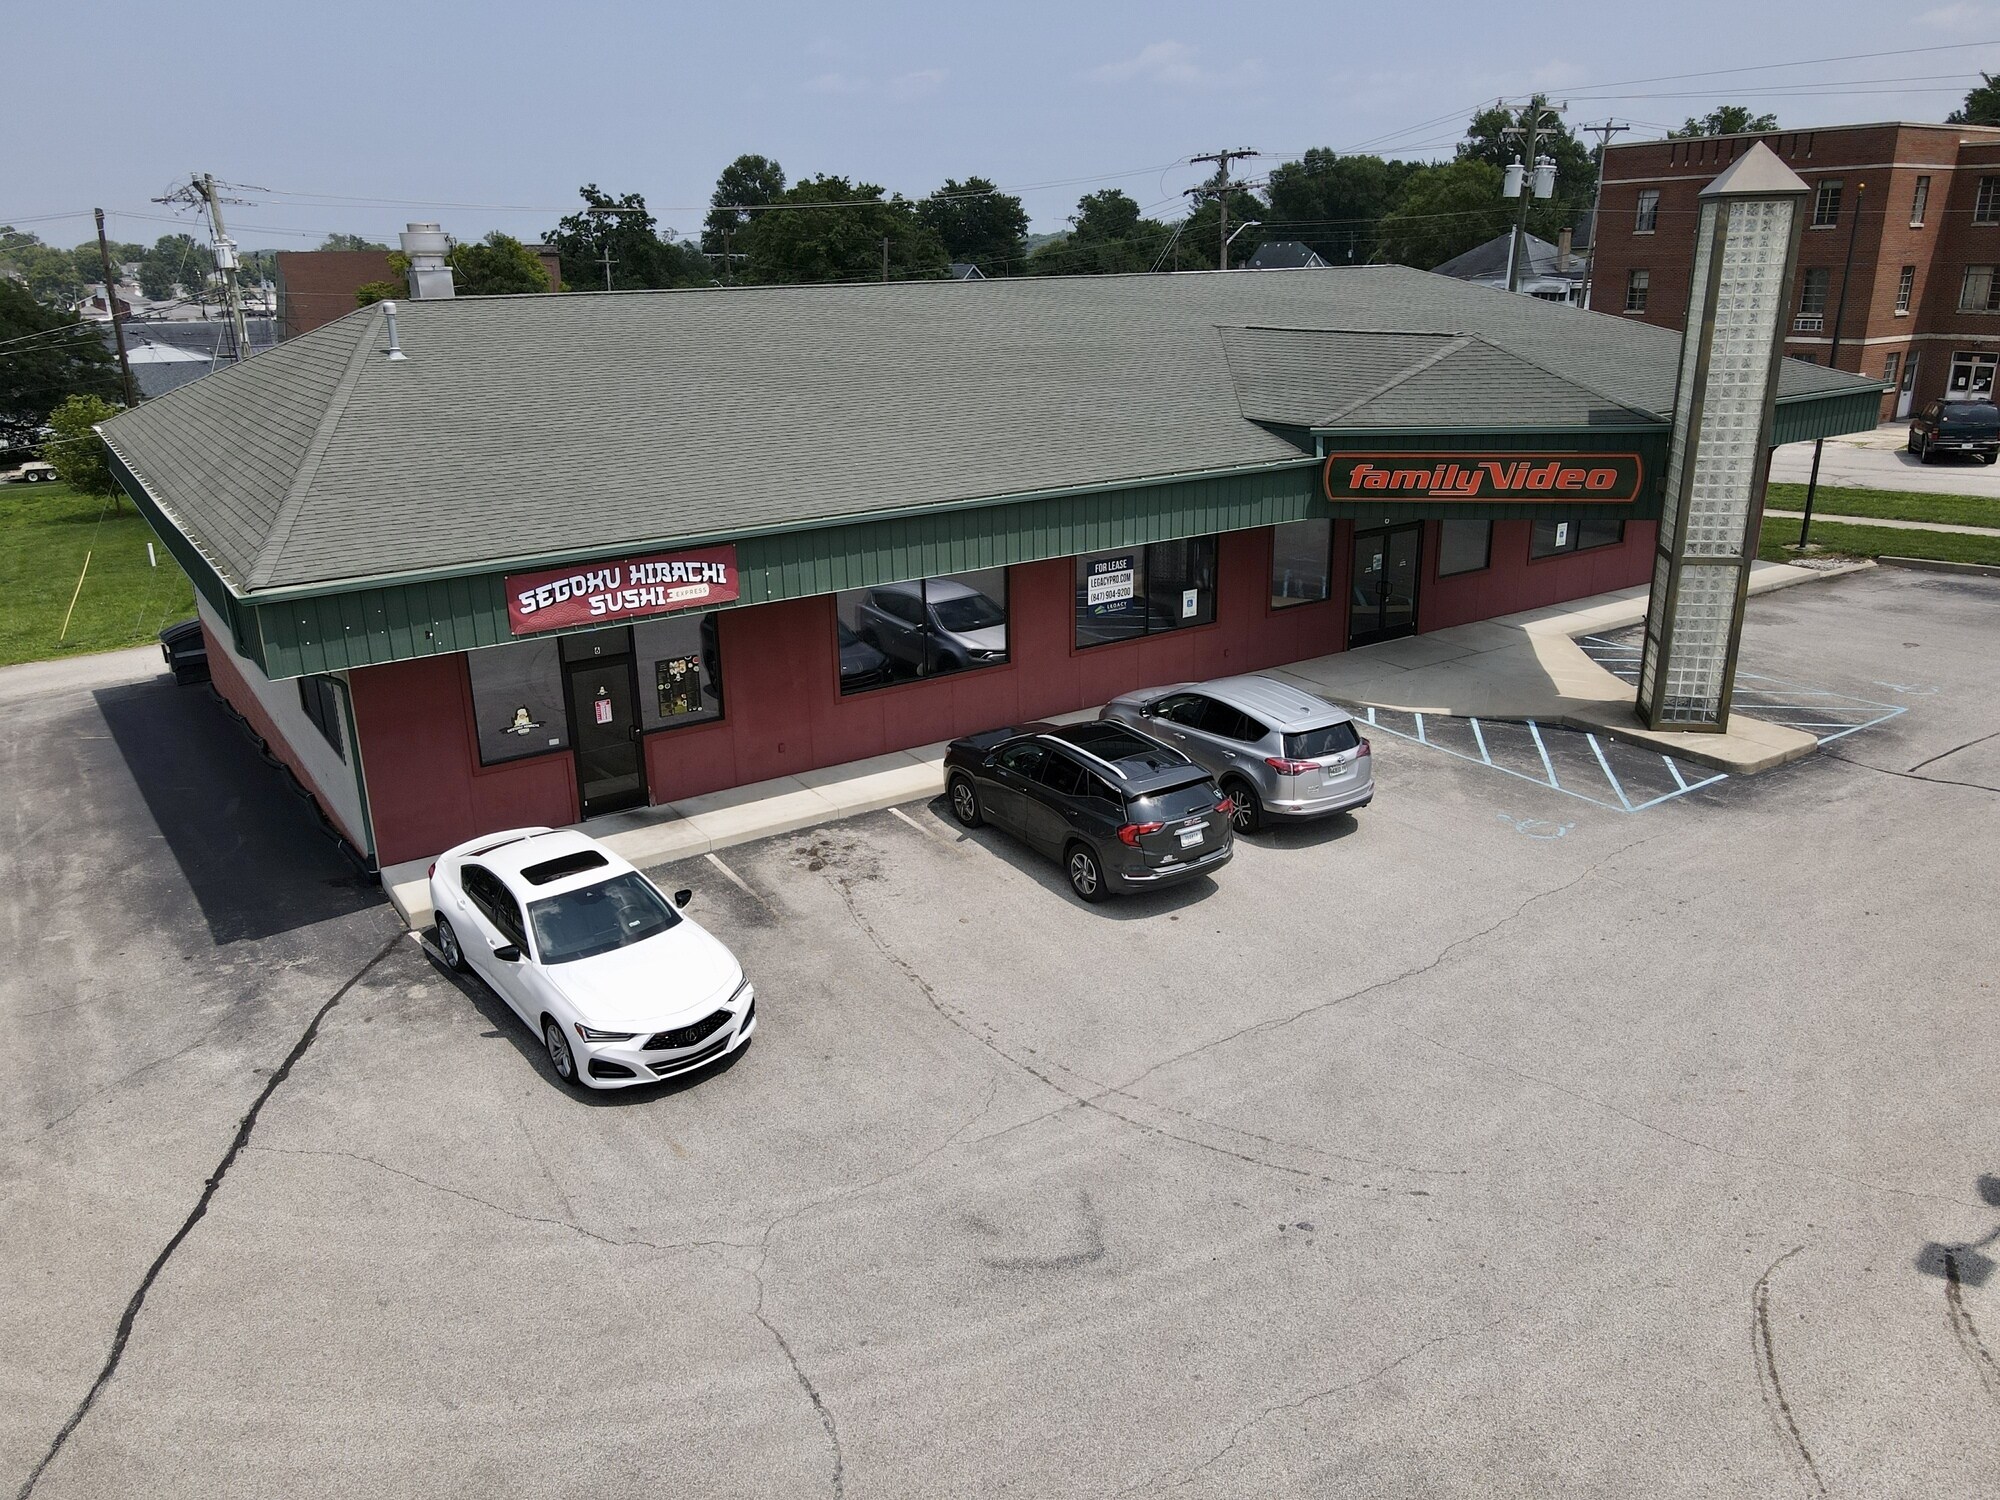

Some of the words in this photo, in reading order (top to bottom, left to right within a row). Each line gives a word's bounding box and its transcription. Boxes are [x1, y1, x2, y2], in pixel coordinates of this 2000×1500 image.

[1094, 563, 1107, 573] FOR
[1108, 559, 1128, 570] LEASE
[518, 567, 621, 614] SEGOKU
[630, 562, 727, 585] HIBACHI
[1090, 572, 1131, 588] LEGACYPRO.COM
[676, 587, 707, 597] EXPRESS
[1090, 591, 1105, 603] (847)
[1106, 587, 1131, 599] 904-9200
[588, 586, 666, 616] SUSHI
[1106, 601, 1127, 609] LEGACY
